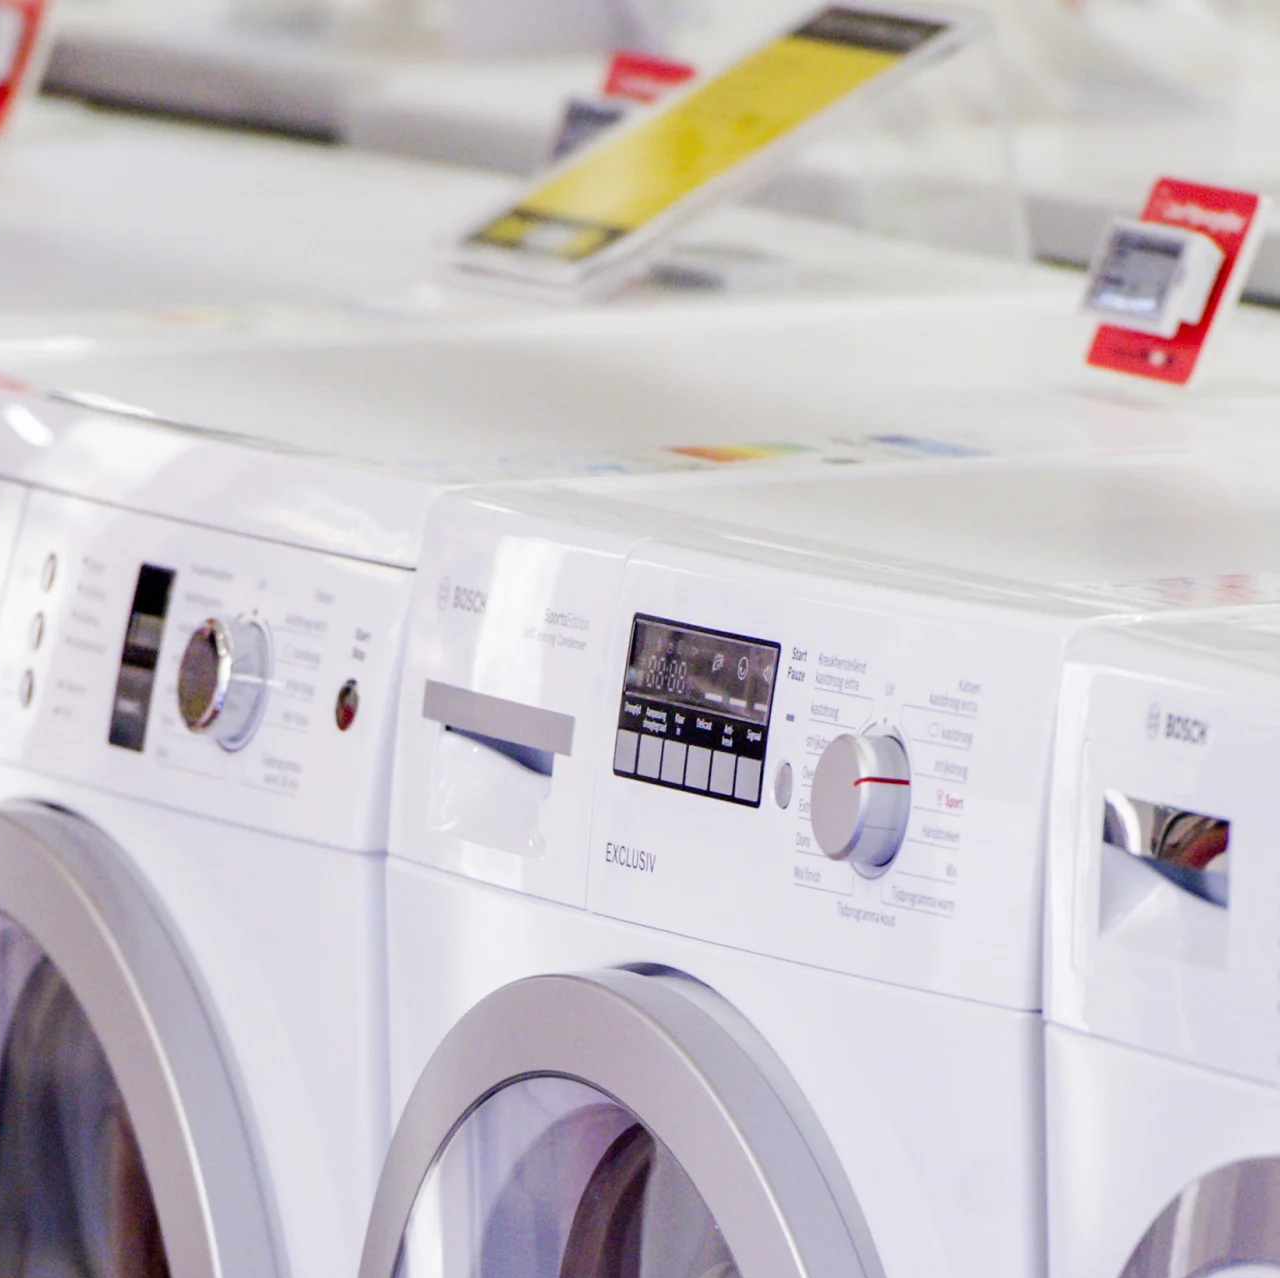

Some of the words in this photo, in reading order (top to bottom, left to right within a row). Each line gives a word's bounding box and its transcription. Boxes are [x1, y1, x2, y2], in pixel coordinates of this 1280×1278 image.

[452, 586, 488, 614] BOSCH
[791, 647, 808, 663] Start
[787, 666, 806, 682] Pauze
[1166, 712, 1209, 745] BOSCH
[945, 793, 965, 811] Sport
[605, 842, 657, 873] EXCLUSIV
